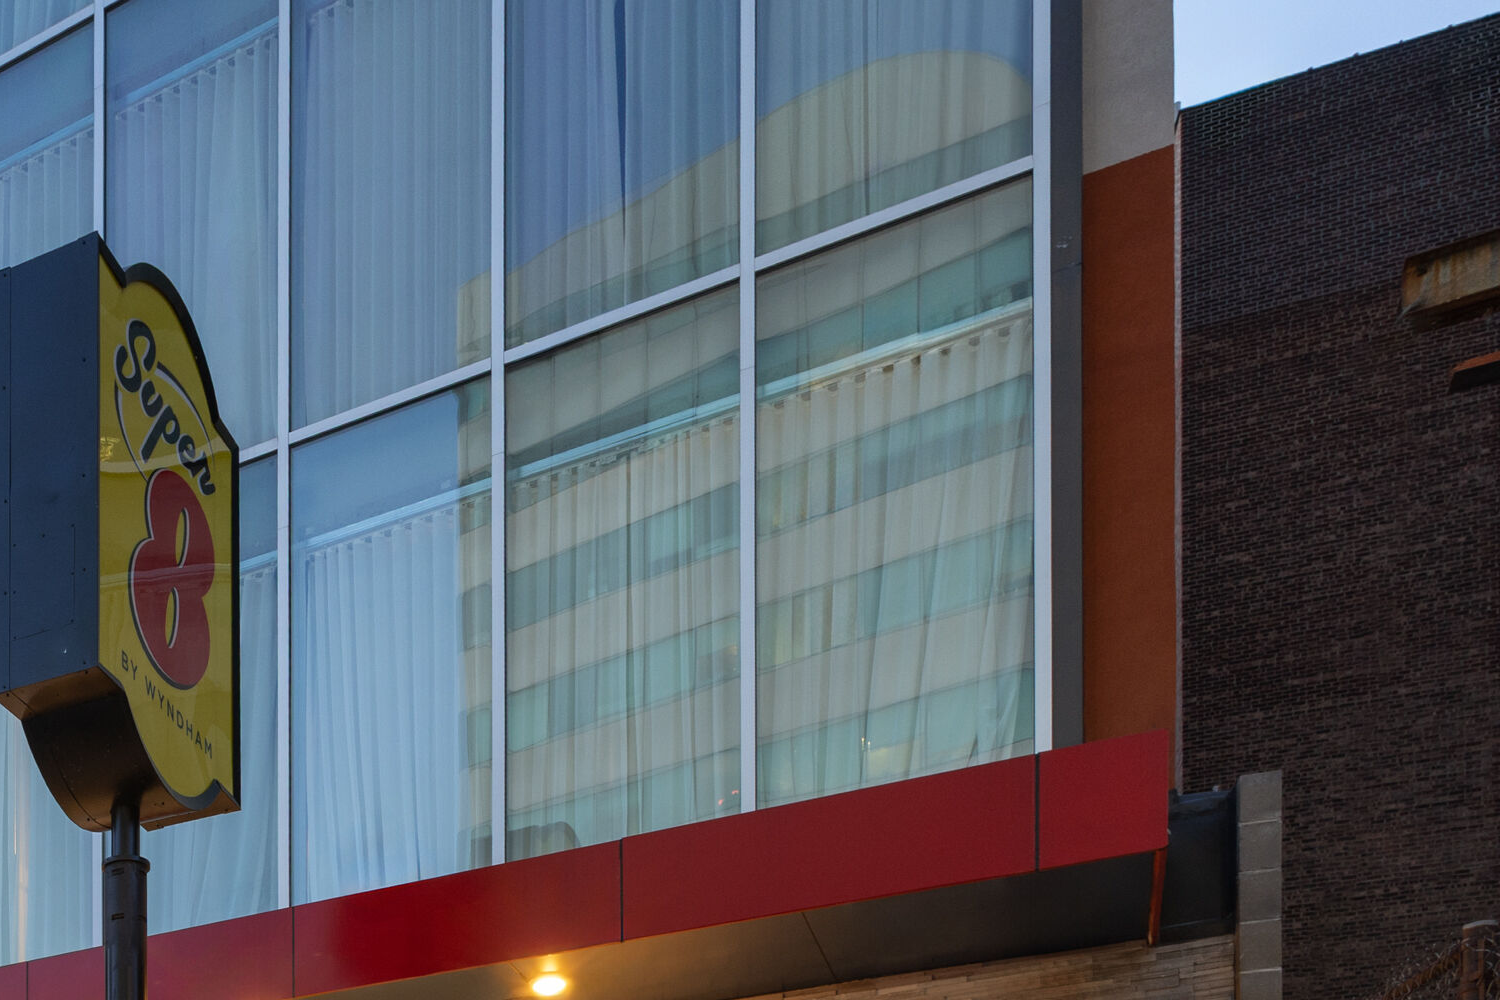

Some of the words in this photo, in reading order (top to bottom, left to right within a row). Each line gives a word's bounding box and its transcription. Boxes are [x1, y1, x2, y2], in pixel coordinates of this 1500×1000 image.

[114, 318, 216, 496] Super
[128, 467, 215, 690] 8
[121, 649, 138, 681] BY
[144, 675, 213, 760] WYNDHAM
